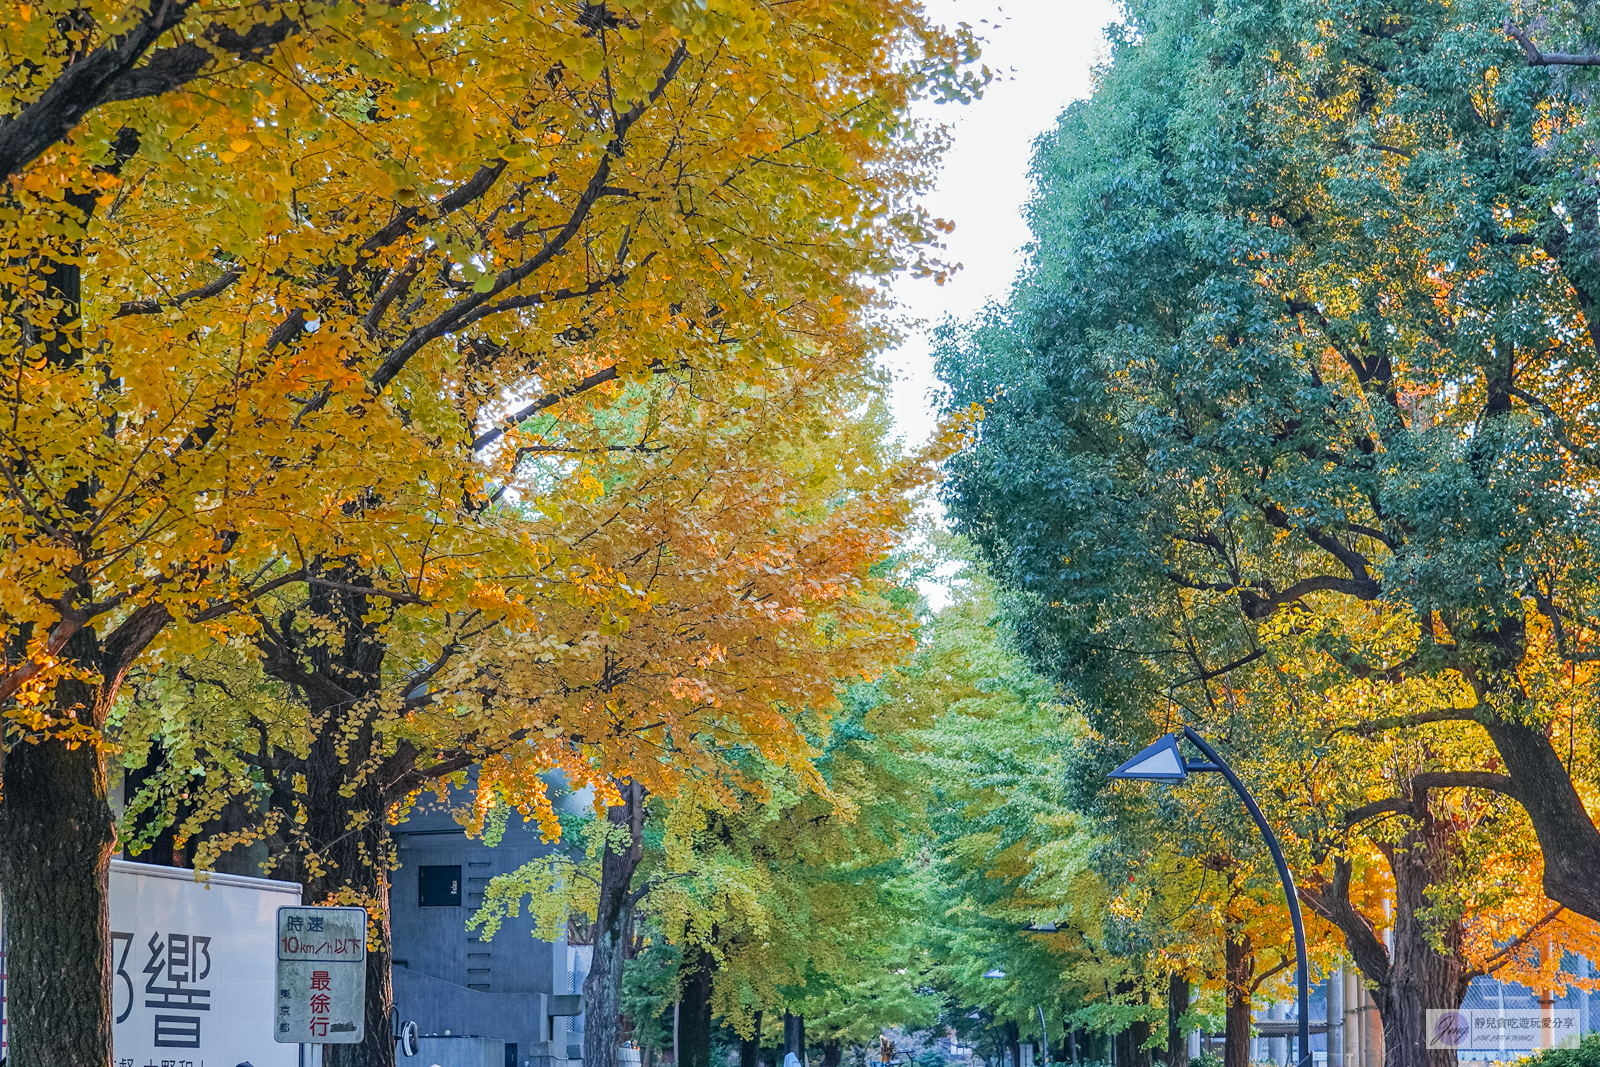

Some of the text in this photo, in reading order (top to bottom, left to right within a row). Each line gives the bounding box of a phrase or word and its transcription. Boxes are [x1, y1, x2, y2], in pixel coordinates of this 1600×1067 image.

[287, 915, 324, 932] 時速
[280, 989, 291, 1033] 東京都
[310, 971, 331, 1037] 最徐行
